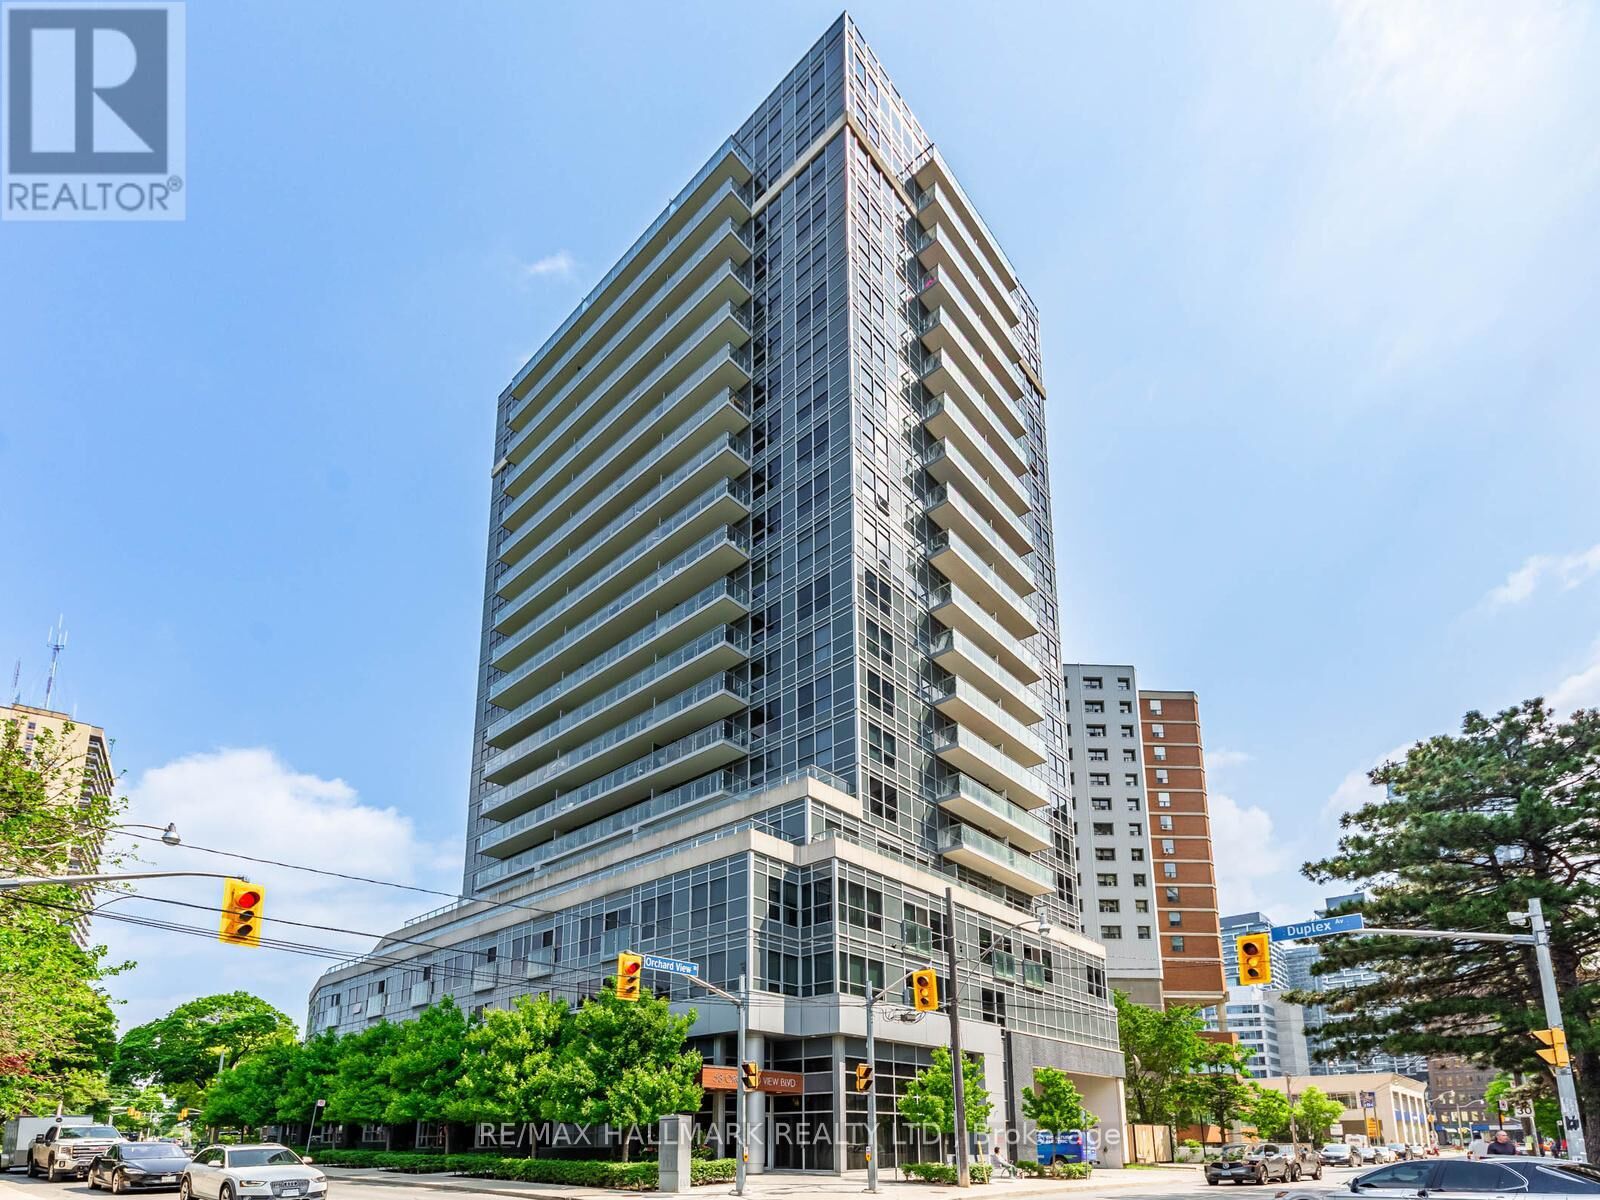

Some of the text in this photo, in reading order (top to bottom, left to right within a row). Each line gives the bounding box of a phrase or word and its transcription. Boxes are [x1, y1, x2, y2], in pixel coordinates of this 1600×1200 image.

[1287, 922, 1331, 936] Duplex
[646, 958, 673, 970] Orchard
[675, 963, 692, 973] View
[762, 1077, 779, 1086] VIEW
[780, 1078, 796, 1088] BLVD
[1516, 1106, 1533, 1115] 30
